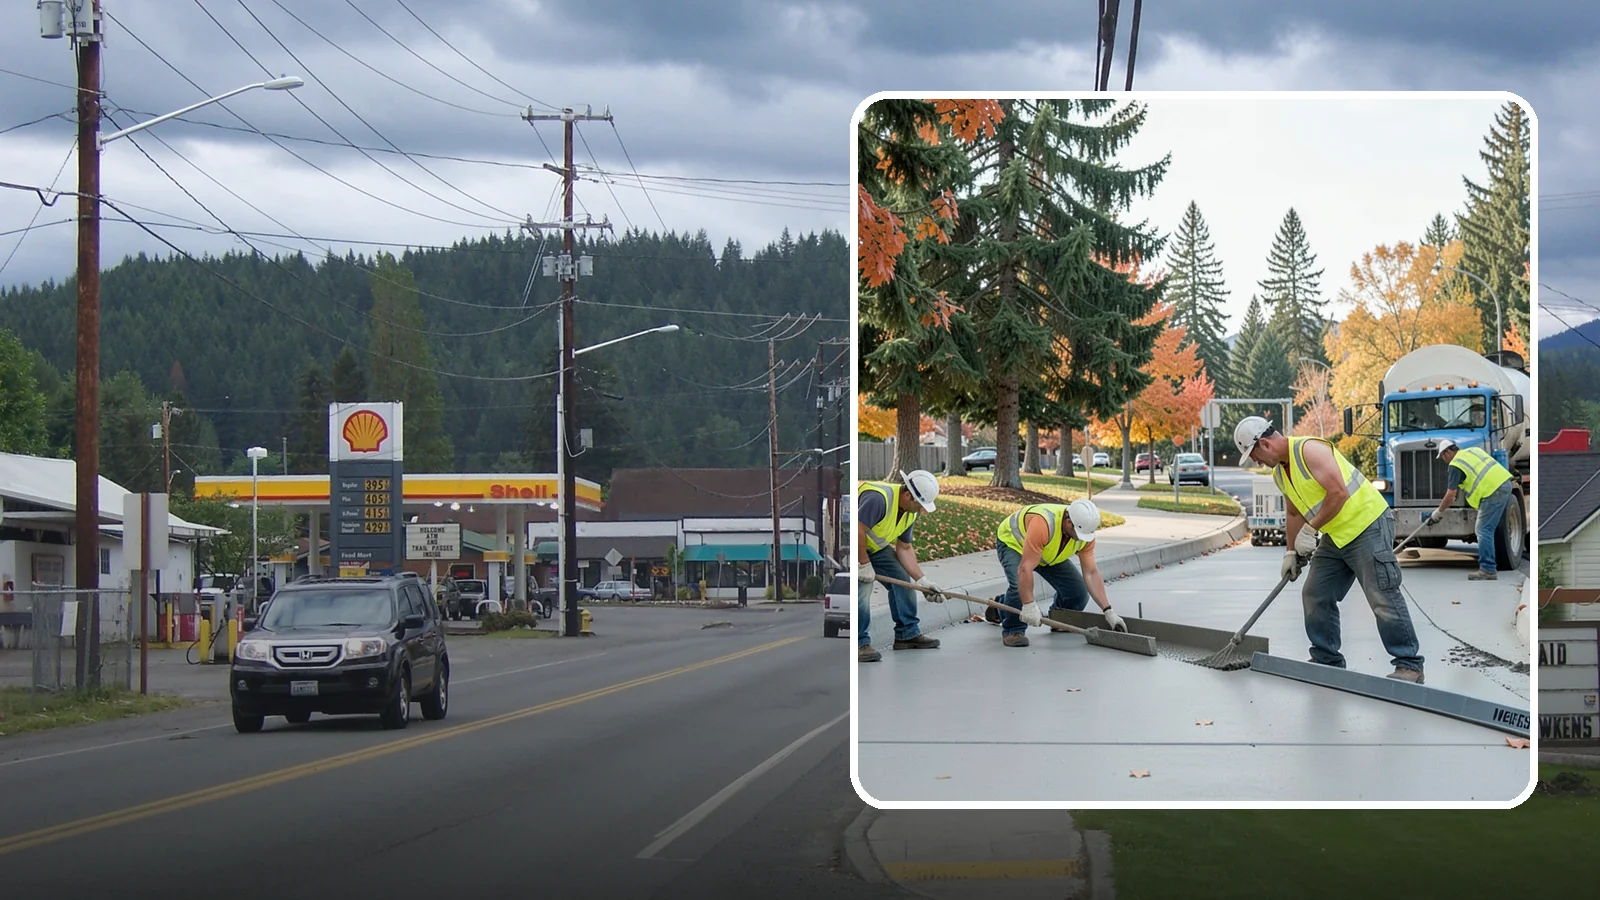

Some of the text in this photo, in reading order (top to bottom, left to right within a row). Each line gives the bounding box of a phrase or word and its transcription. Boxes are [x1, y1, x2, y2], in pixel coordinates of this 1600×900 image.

[366, 480, 384, 490] 395
[490, 484, 547, 499] Shell
[366, 494, 384, 504] 405
[366, 508, 384, 518] 415
[366, 522, 384, 532] 429
